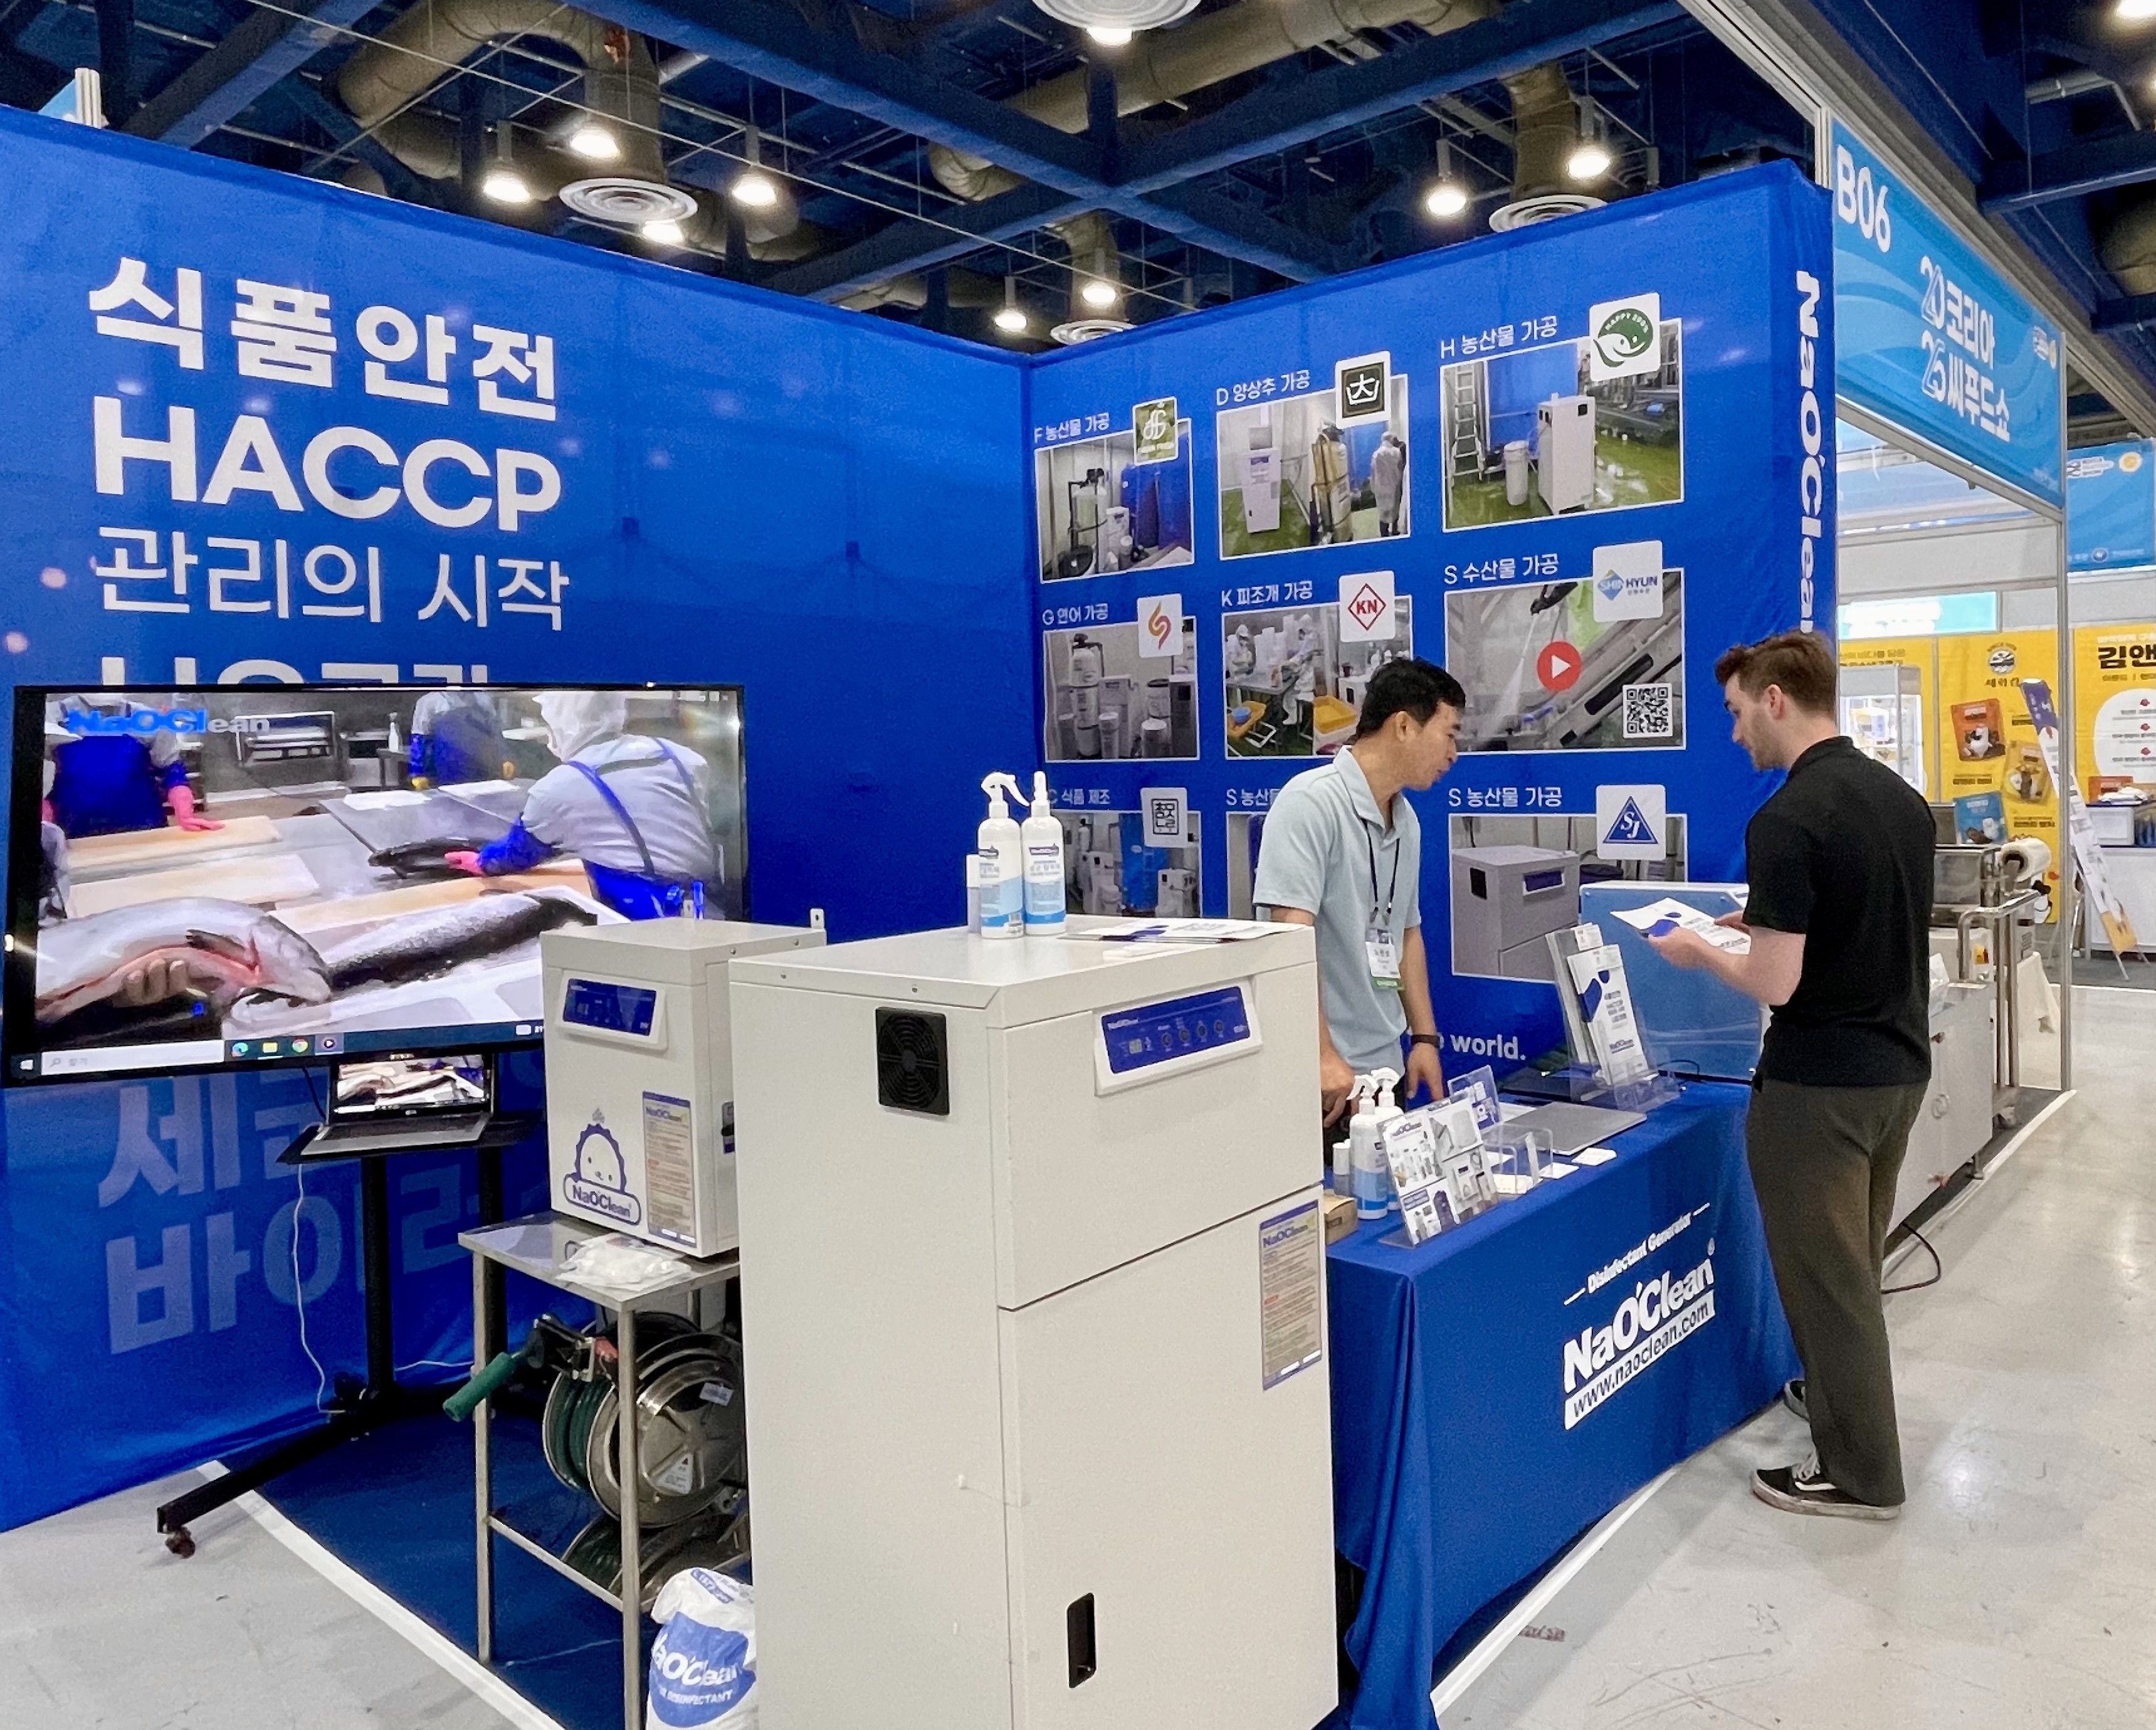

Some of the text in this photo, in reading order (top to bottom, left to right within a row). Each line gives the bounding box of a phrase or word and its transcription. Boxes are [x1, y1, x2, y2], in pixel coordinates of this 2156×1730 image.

[1837, 144, 1891, 253] B06
[89, 256, 556, 421] 식품안전
[1441, 315, 1559, 359] H 농산물 가공
[1946, 279, 1996, 371] 코리아
[1216, 369, 1310, 406] D 양상추 가공
[1947, 353, 2010, 442] 씨푸드쇼
[1034, 412, 1110, 443] F 농산물 가공
[93, 396, 561, 532] HACCP
[96, 526, 569, 631] 관리의 시작
[1444, 552, 1559, 584] S 수산물 가공
[1625, 576, 1658, 589] HYUN
[1221, 580, 1313, 607] K 피조개 가공
[1355, 599, 1379, 615] KN
[1042, 603, 1108, 626] G 연어 가공
[1061, 788, 1085, 806] 식품
[1088, 788, 1111, 804] 제조
[1226, 790, 1237, 805] S
[1448, 785, 1562, 808] S 농산물 가공
[1620, 811, 1640, 838] SJ
[1449, 1033, 1526, 1060] world.
[1573, 1299, 1710, 1418] www.naoclean.com
